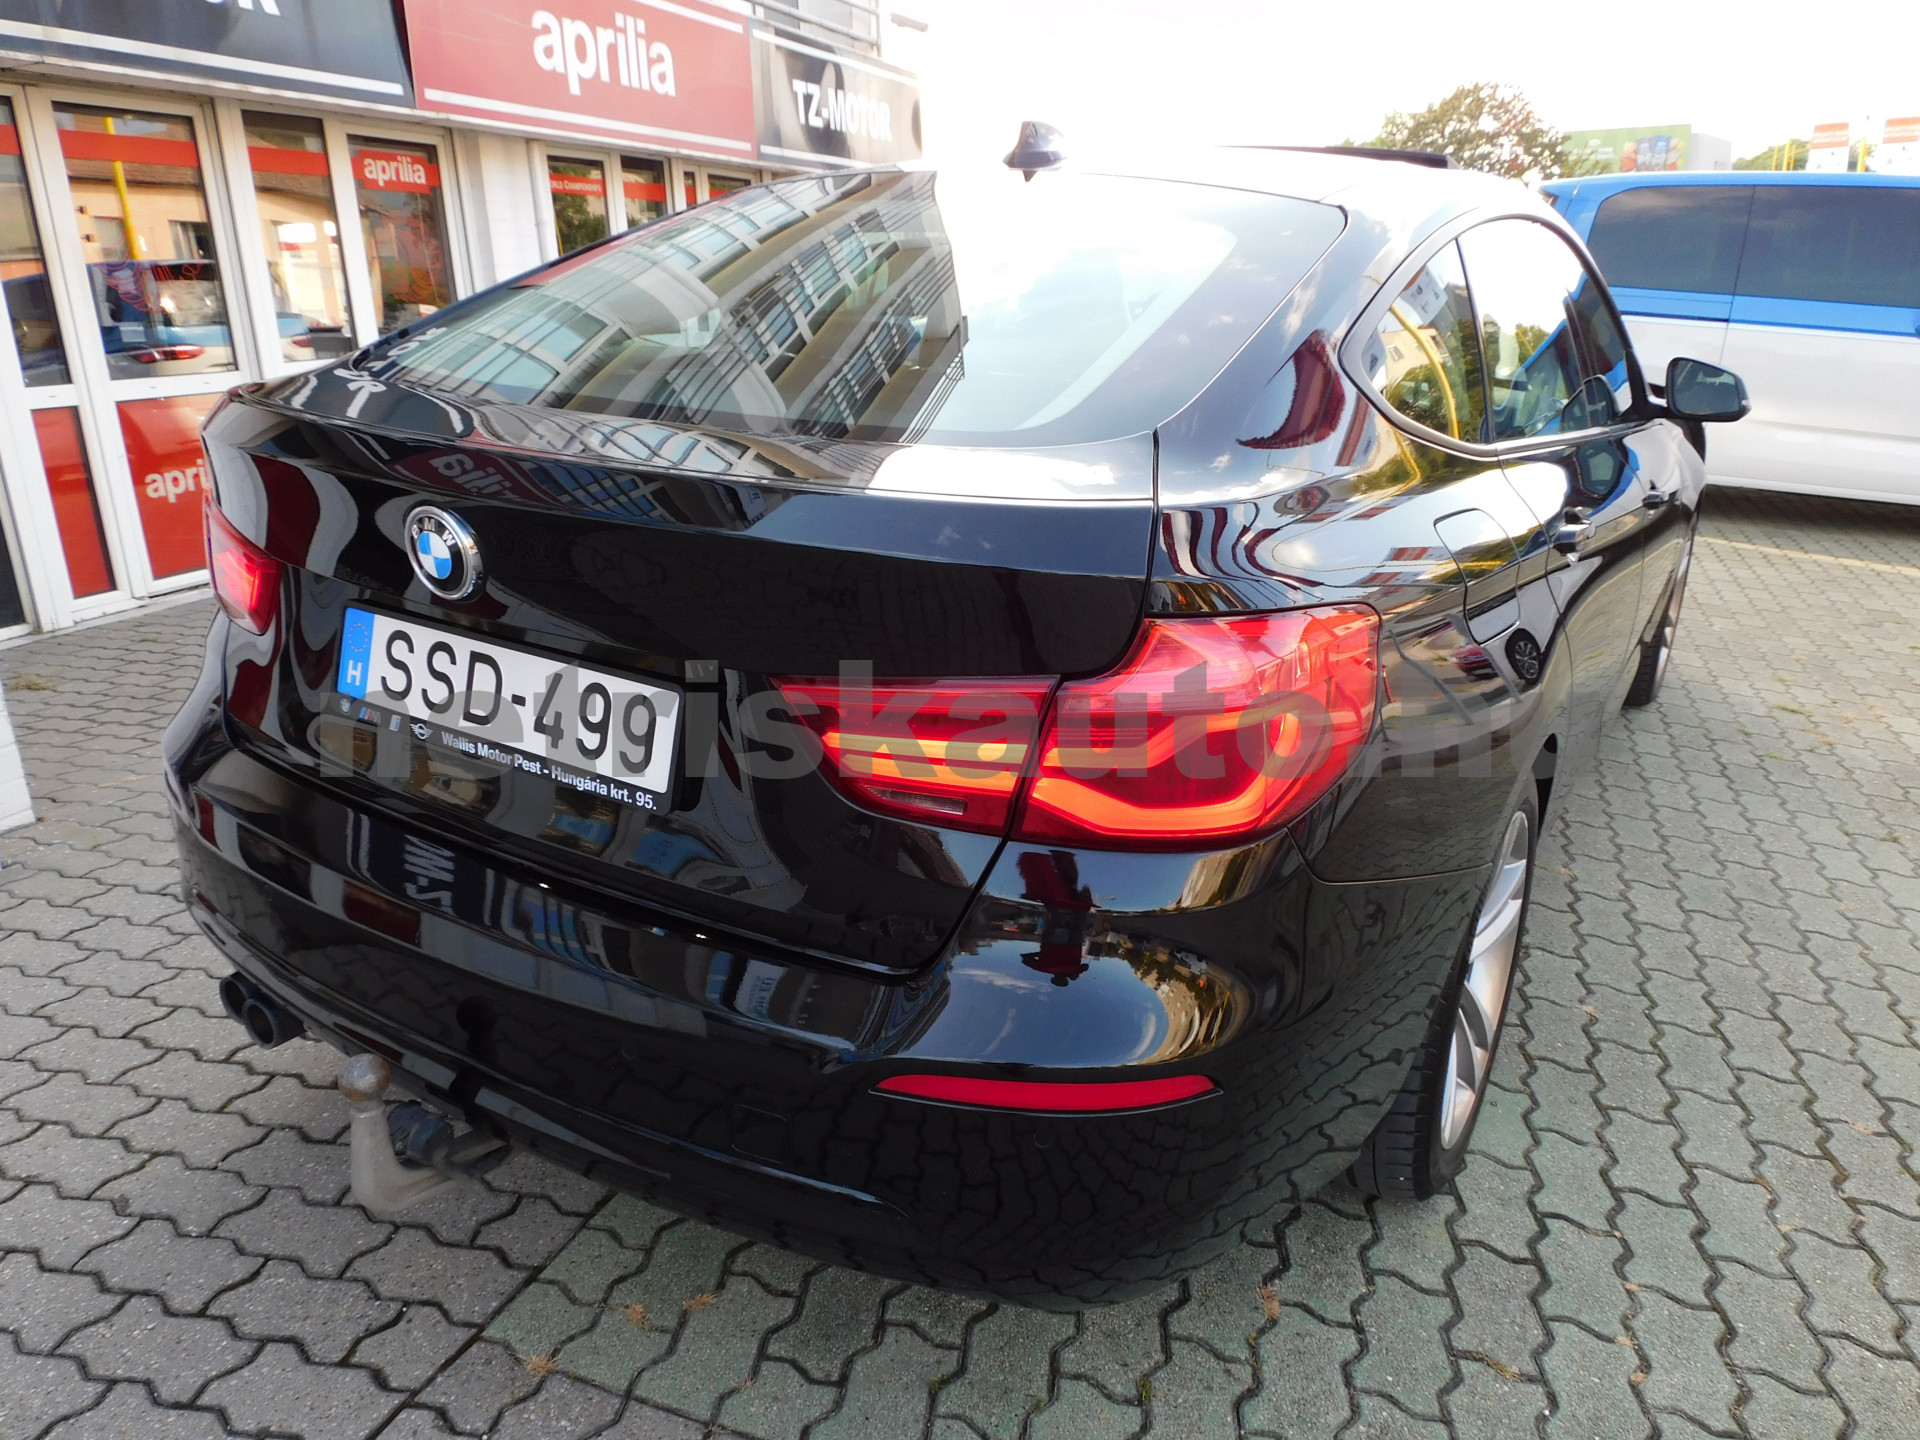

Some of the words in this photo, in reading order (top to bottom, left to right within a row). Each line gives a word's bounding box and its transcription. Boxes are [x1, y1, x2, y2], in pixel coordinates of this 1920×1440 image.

[531, 9, 677, 98] aprilia
[792, 78, 893, 143] TZ-MOTOR
[363, 155, 427, 187] aprilia
[411, 517, 457, 547] BMW
[346, 659, 362, 686] H
[380, 629, 658, 774] SSD-499
[441, 731, 476, 754] Wallis
[477, 742, 512, 765] Motor
[514, 753, 541, 775] Pest
[551, 765, 608, 795] Hungária
[610, 783, 633, 803] krt.
[635, 791, 657, 810] 95.
